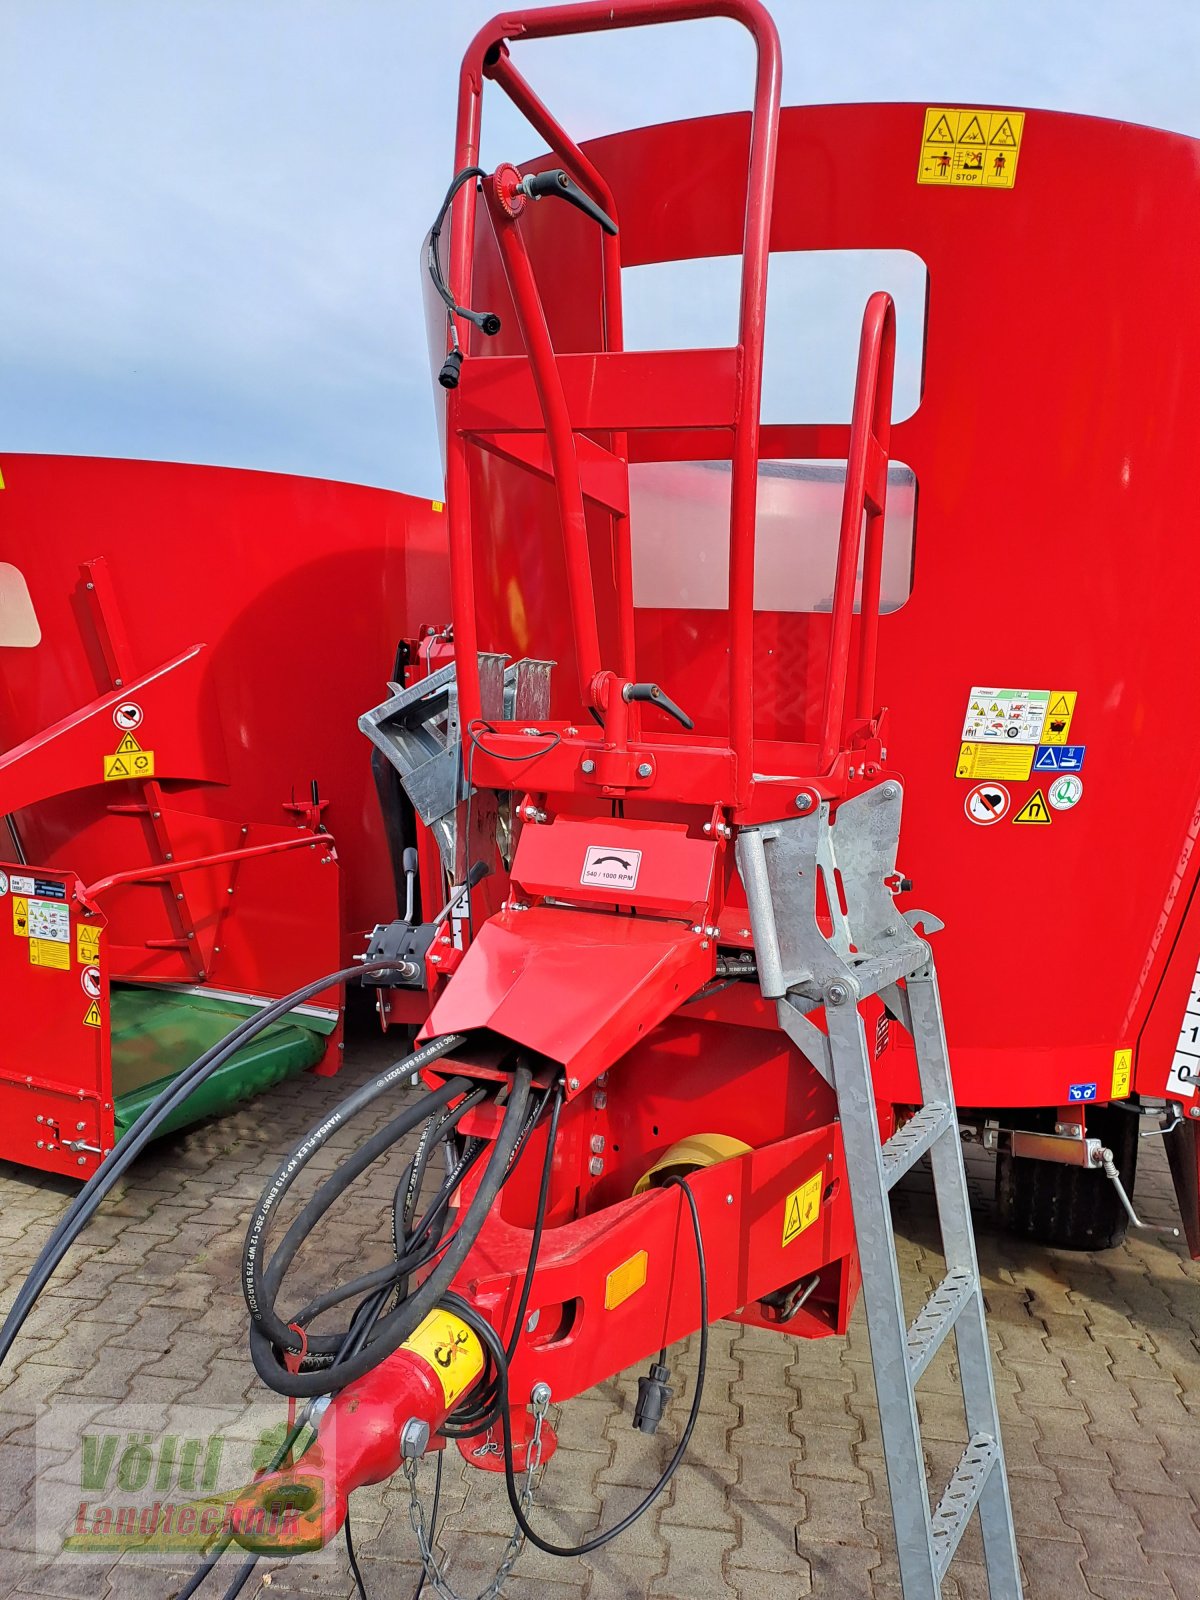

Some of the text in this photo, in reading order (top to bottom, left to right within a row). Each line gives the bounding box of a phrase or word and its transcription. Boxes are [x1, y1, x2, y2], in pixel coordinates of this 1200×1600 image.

[955, 173, 978, 182] STOP
[586, 870, 598, 878] 540
[603, 872, 617, 880] 1000
[618, 873, 633, 881] RPM
[1190, 1026, 1199, 1043] 1
[413, 1052, 426, 1063] 275
[426, 1044, 438, 1057] WP
[1177, 1065, 1191, 1083] 0
[296, 1112, 342, 1160] HANSA-FLEX
[287, 1159, 298, 1173] KP
[275, 1171, 289, 1187] 213
[261, 1186, 279, 1215] EN857
[253, 1214, 265, 1233] 2SC
[250, 1234, 259, 1245] 12
[246, 1245, 257, 1260] WP
[246, 1261, 254, 1276] 275
